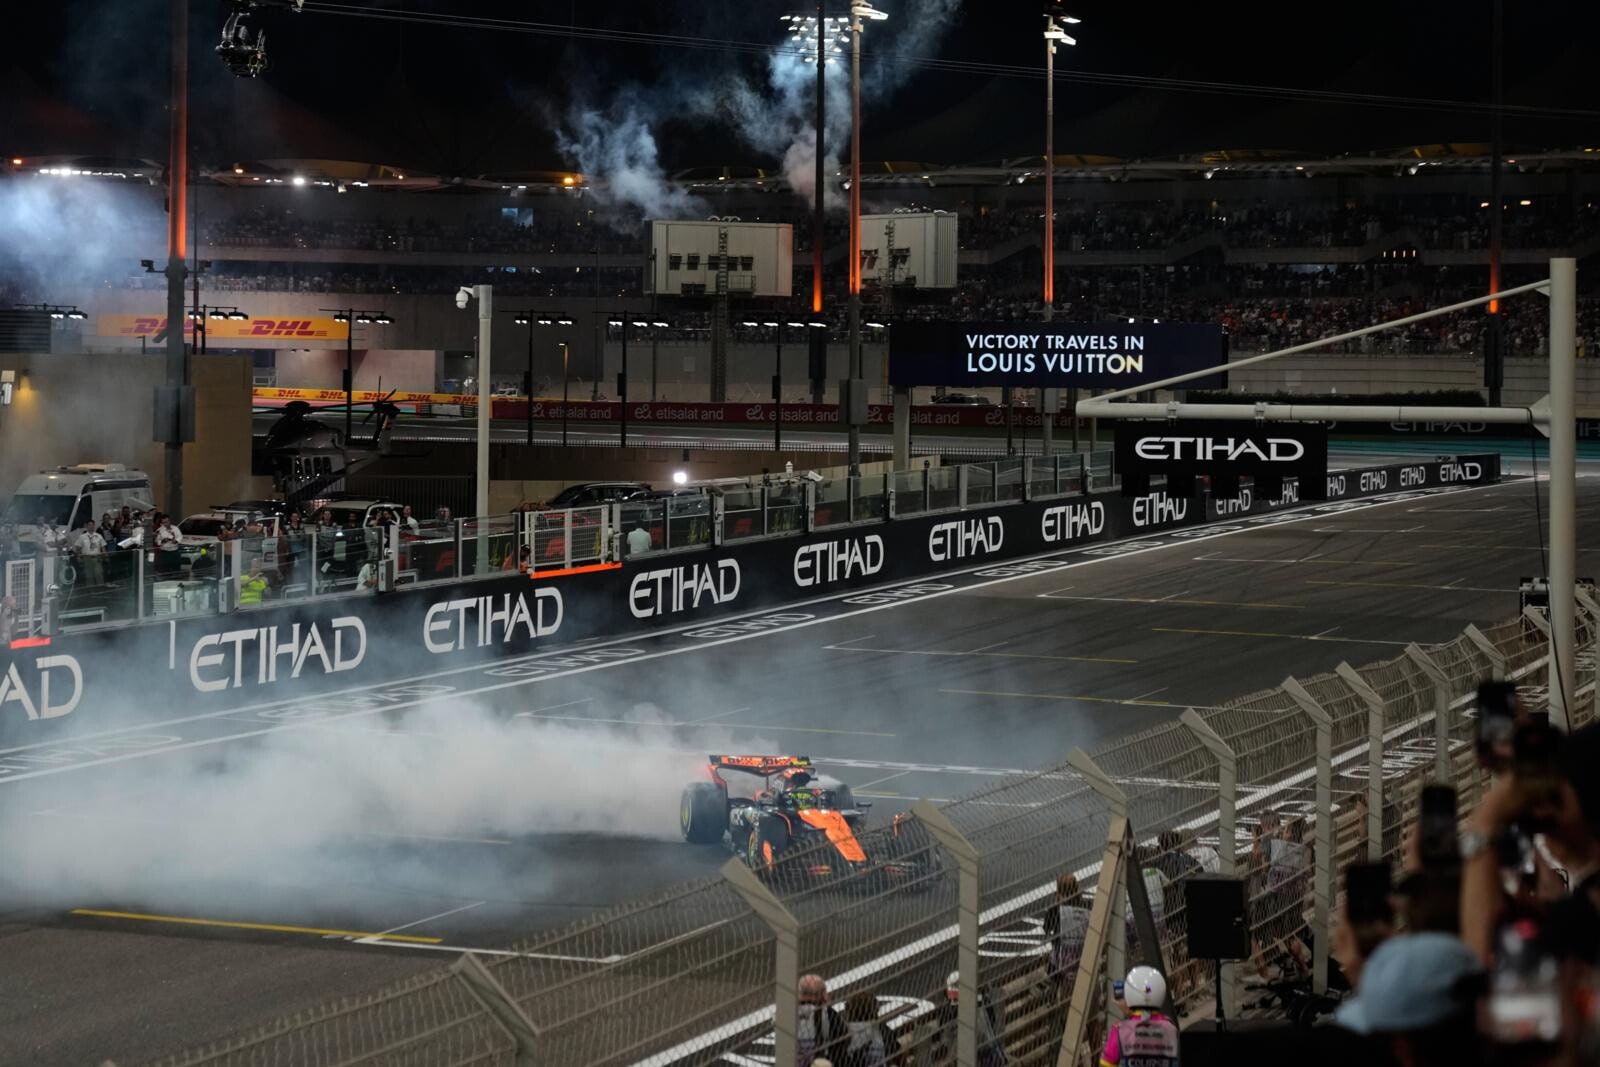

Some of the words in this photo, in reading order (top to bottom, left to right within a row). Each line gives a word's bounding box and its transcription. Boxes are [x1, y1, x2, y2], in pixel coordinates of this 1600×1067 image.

[251, 320, 315, 336] DHL
[966, 334, 1038, 350] VICTORY
[1045, 334, 1118, 350] TRAVELS
[1124, 334, 1144, 350] IN
[967, 353, 1035, 373] LOUIS
[1042, 353, 1144, 374] VUITTON
[320, 391, 344, 399] DHL
[407, 394, 432, 402] DHL
[452, 395, 477, 404] DHL
[549, 406, 587, 418] etialat
[590, 407, 612, 419] and
[656, 406, 699, 421] etisalat
[701, 407, 723, 421] and
[769, 408, 813, 422] eisalat
[815, 408, 838, 422] and
[887, 410, 933, 424] ealat
[935, 411, 960, 425] and
[1134, 436, 1305, 462] ETIHAD
[1360, 470, 1388, 492] ETIHAD
[1400, 466, 1426, 487] ETIHAD
[1440, 462, 1482, 482] ETIHAD
[1132, 491, 1187, 527] ETIHAD
[1042, 500, 1105, 542] ETIHAD
[929, 515, 1004, 562] ETIHAD
[793, 534, 884, 587] ETIHAD
[974, 560, 1069, 577] ETIHAD
[628, 558, 741, 619] ETIHAD
[843, 583, 955, 605] ETIHAD
[423, 586, 564, 654] ETIHAD
[681, 612, 816, 639] ETIHAD
[189, 615, 367, 693] ETIHAD
[484, 648, 646, 677] ETIHAD
